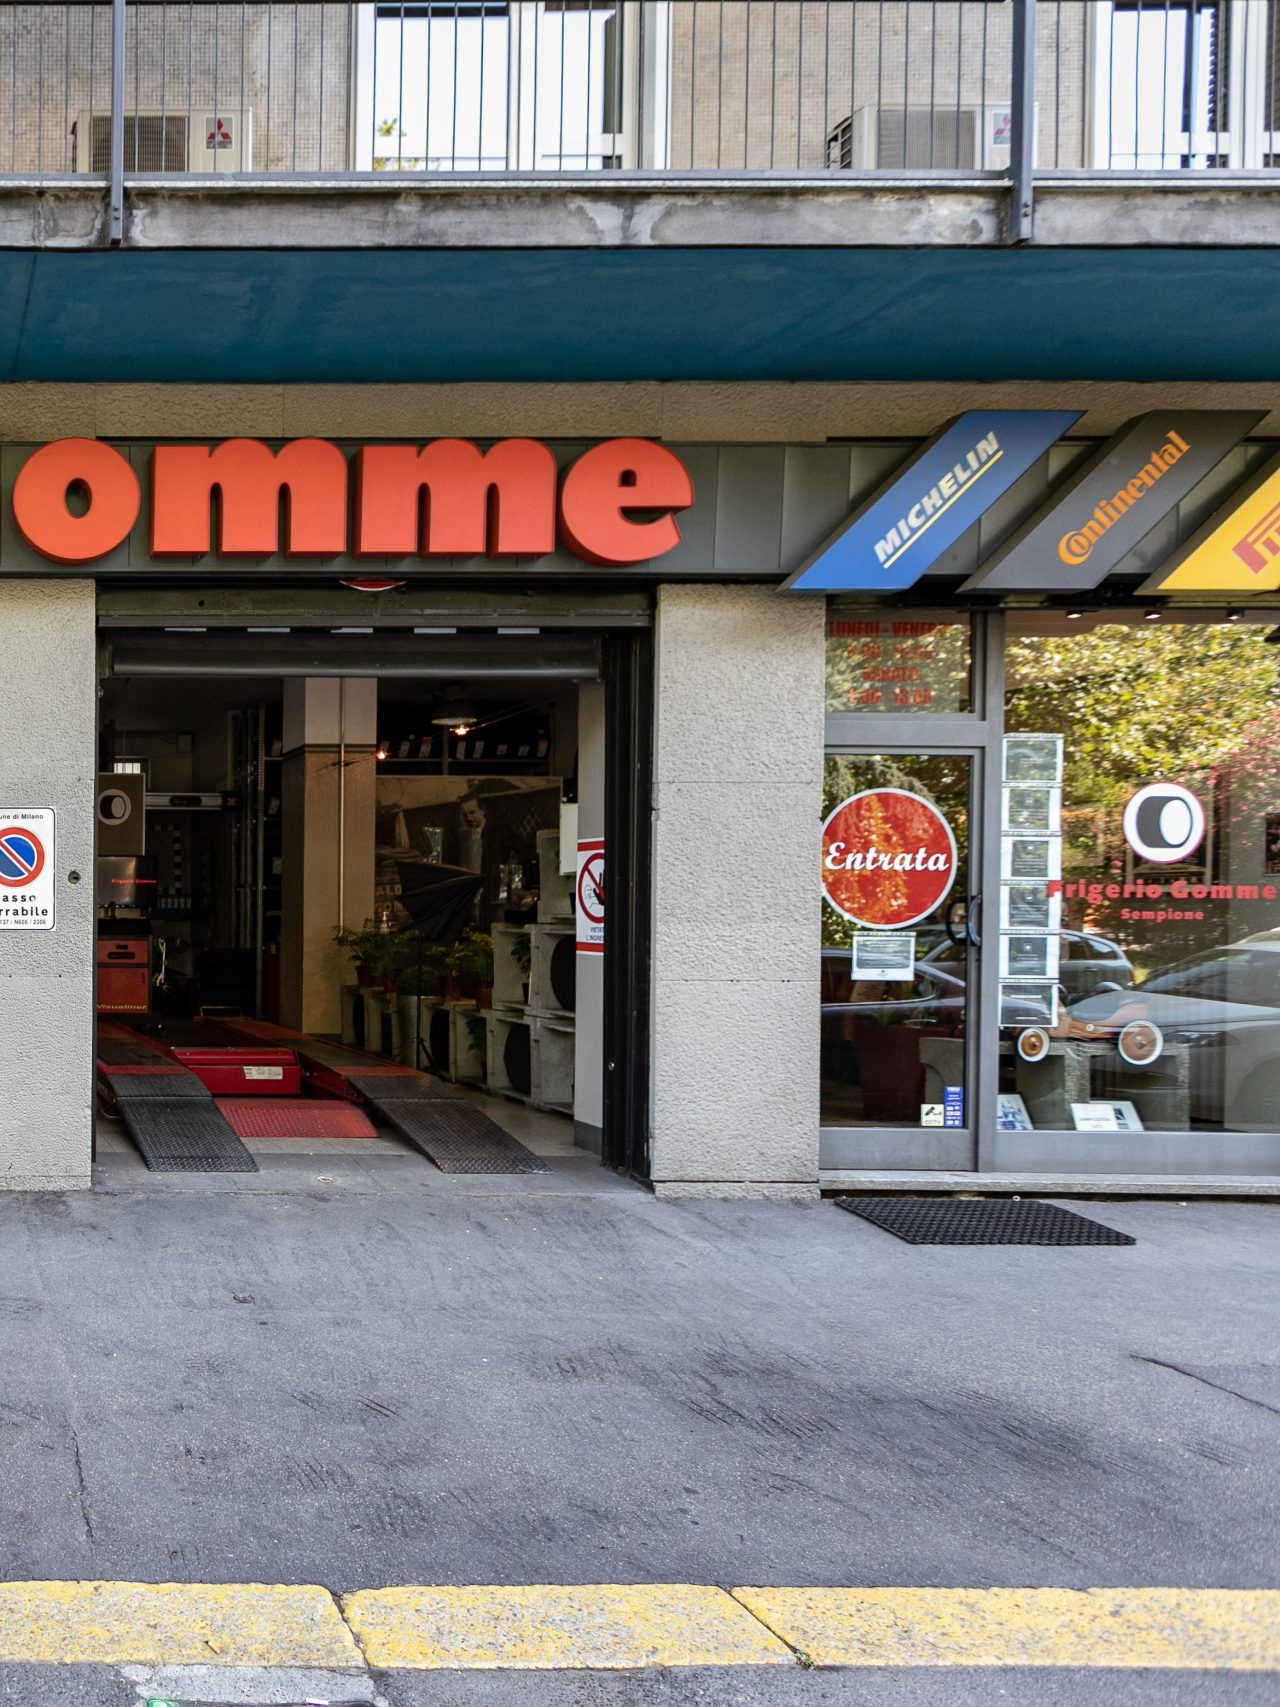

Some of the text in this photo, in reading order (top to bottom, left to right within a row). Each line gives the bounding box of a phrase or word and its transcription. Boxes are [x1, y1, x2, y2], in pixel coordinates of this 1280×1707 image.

[873, 431, 1002, 564] MICHELIN
[1058, 430, 1192, 565] Continental
[824, 842, 950, 871] Entrata
[1047, 879, 1279, 905] Frigerio Gomme
[1121, 908, 1205, 923] Sempione
